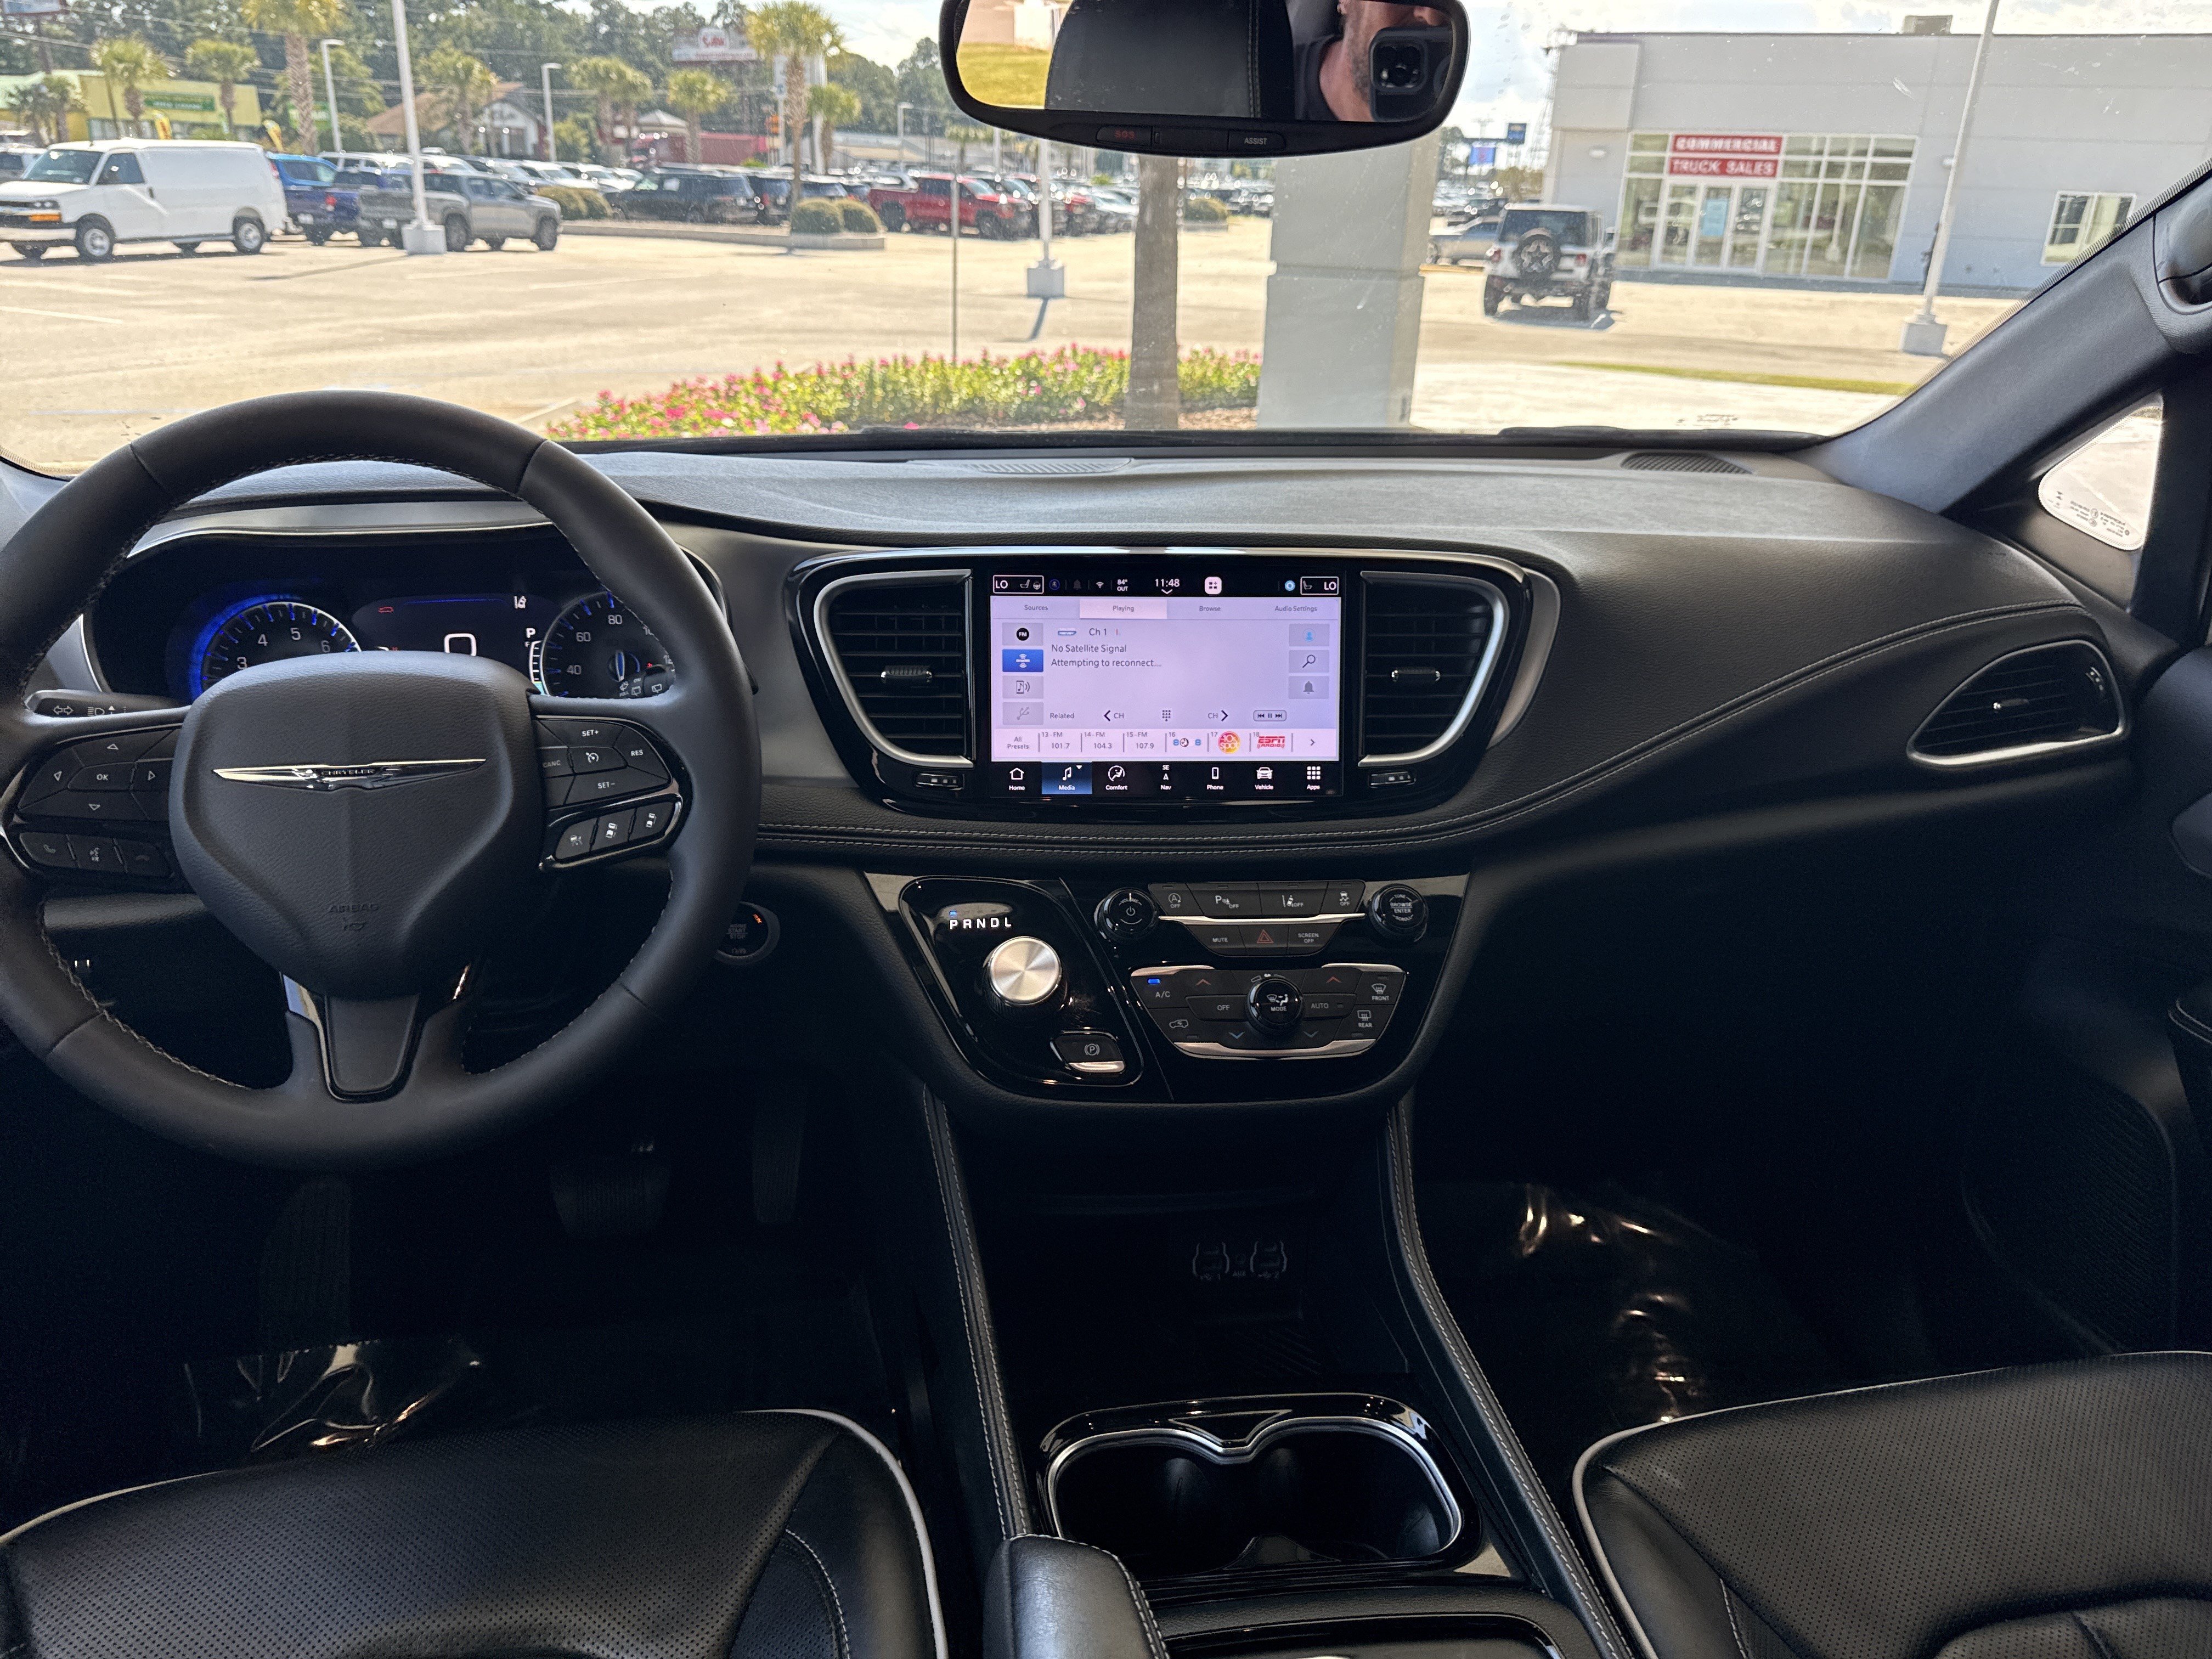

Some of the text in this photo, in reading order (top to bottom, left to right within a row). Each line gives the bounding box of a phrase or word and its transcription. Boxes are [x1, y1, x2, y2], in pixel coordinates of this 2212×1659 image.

[1675, 137, 1777, 152] COMMERCIAL
[1673, 160, 1775, 176] TRUCK SALES
[995, 580, 1008, 589] LO
[1155, 578, 1180, 588] 11:48
[1324, 582, 1336, 590] LO
[608, 614, 623, 624] 80
[291, 628, 301, 640] 5
[526, 628, 535, 638] P
[576, 631, 591, 641] 60
[258, 634, 268, 646] 4
[321, 640, 331, 653] 6
[1065, 644, 1099, 652] Satellite
[1101, 644, 1127, 654] Signal
[236, 657, 247, 669] 3
[1051, 658, 1100, 668] Attempting
[567, 665, 582, 675] 40
